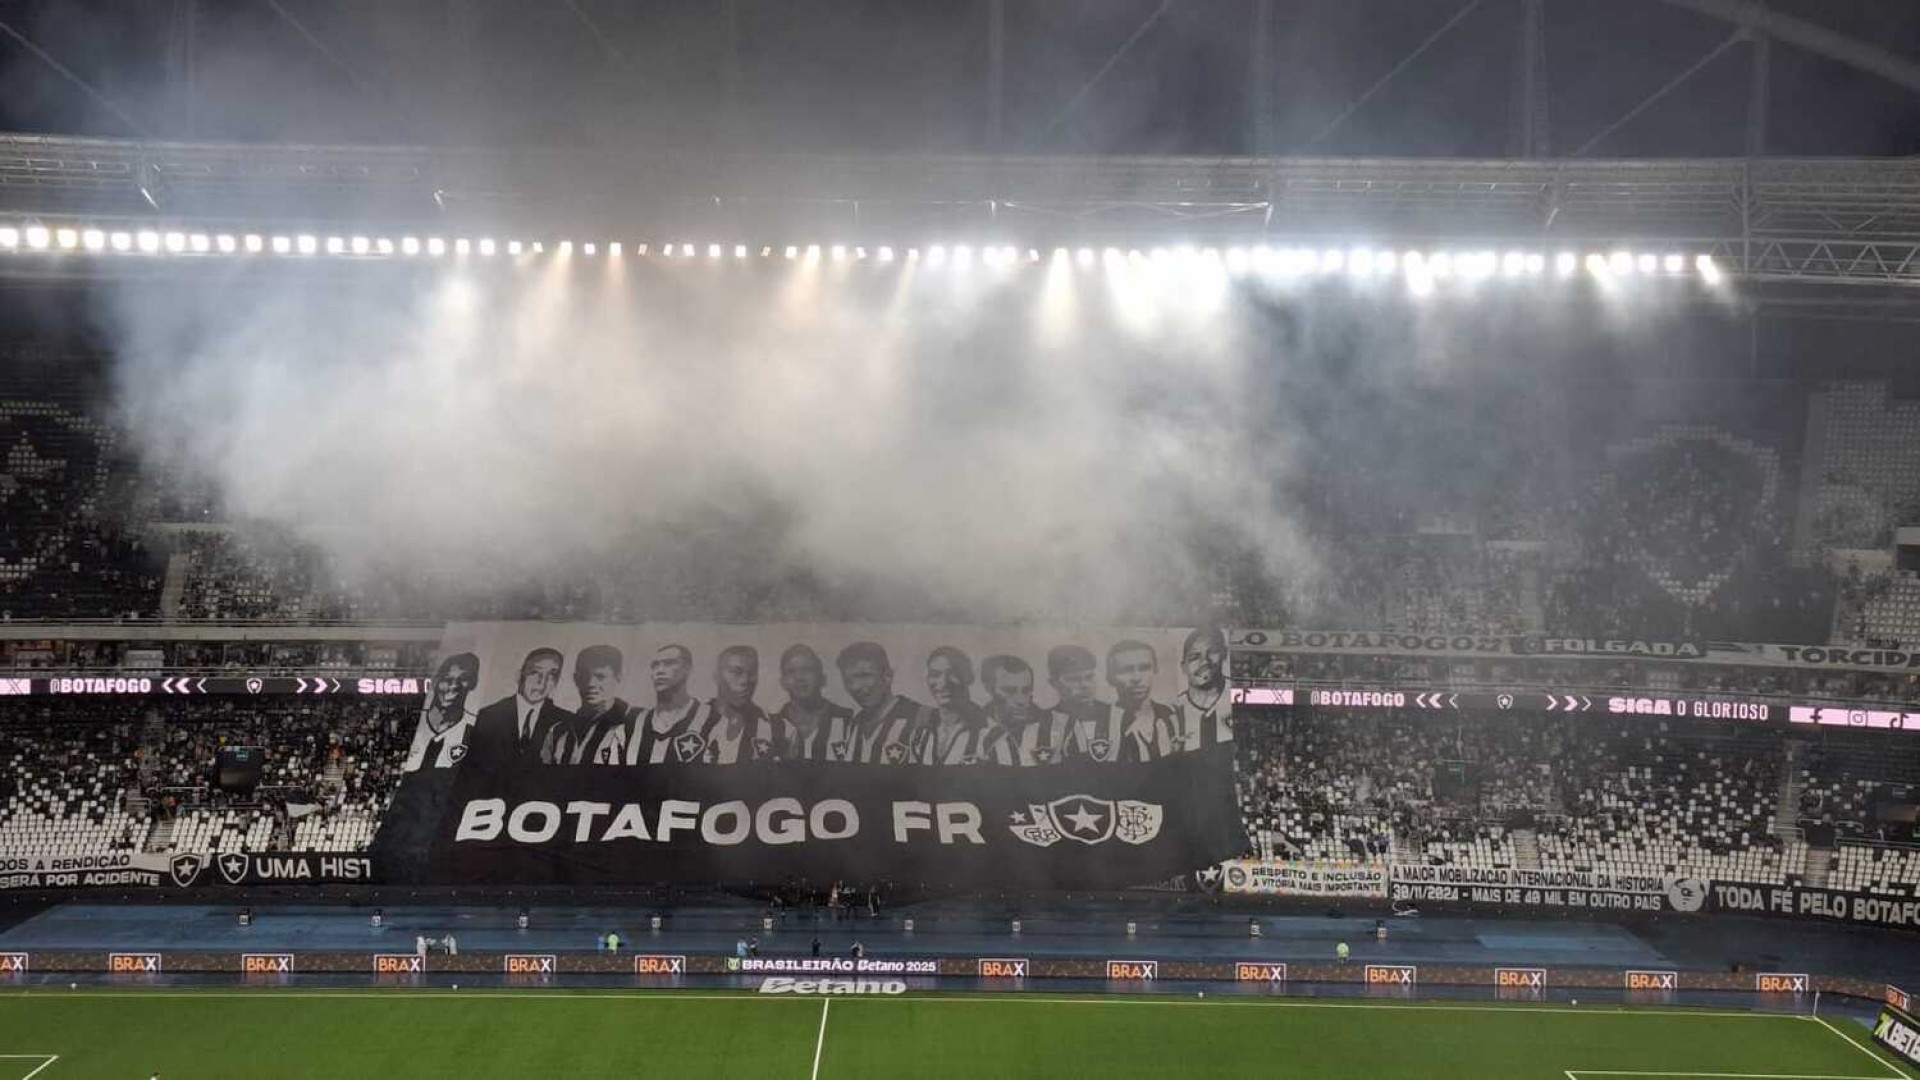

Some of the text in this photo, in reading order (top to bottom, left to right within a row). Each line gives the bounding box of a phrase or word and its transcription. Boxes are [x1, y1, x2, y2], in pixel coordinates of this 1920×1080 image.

[1282, 632, 1475, 651] BOTAFOGO
[50, 678, 152, 694] @BOTAFOGO
[357, 678, 419, 694] SIGA
[1609, 698, 1672, 715] SIGA
[1694, 702, 1769, 720] GLORIOSO
[455, 797, 986, 844] BOTAFOGO FR
[256, 857, 312, 879] UMA
[45, 874, 78, 887] POR
[83, 871, 160, 887] ACIDENTE
[1403, 866, 1435, 882] MAIOR
[1598, 873, 1611, 889] DA
[1472, 886, 1501, 902] MAIS
[1505, 888, 1522, 903] DE
[1545, 890, 1566, 906] MIL
[1568, 891, 1587, 907] EM
[1590, 893, 1631, 908] OUTRO
[1715, 885, 1765, 911] TODA
[1771, 886, 1793, 913] FÉ
[1800, 892, 1847, 919] PELO
[114, 957, 157, 970] BRAX
[247, 957, 289, 971] BRAX
[379, 958, 421, 972] BRAX
[509, 958, 551, 972] BRAX
[639, 959, 681, 972] BRAX
[741, 957, 937, 972] BRASILEIRÃO Betano 2025
[983, 962, 1024, 976] BRAX
[1111, 964, 1153, 978] BRAX
[1241, 966, 1281, 980] BRAX
[1369, 969, 1411, 982] BRAX
[759, 976, 907, 994] Betano
[1499, 972, 1541, 985] BRAX
[1631, 974, 1672, 988] BRAX
[1761, 977, 1803, 991] BRAX
